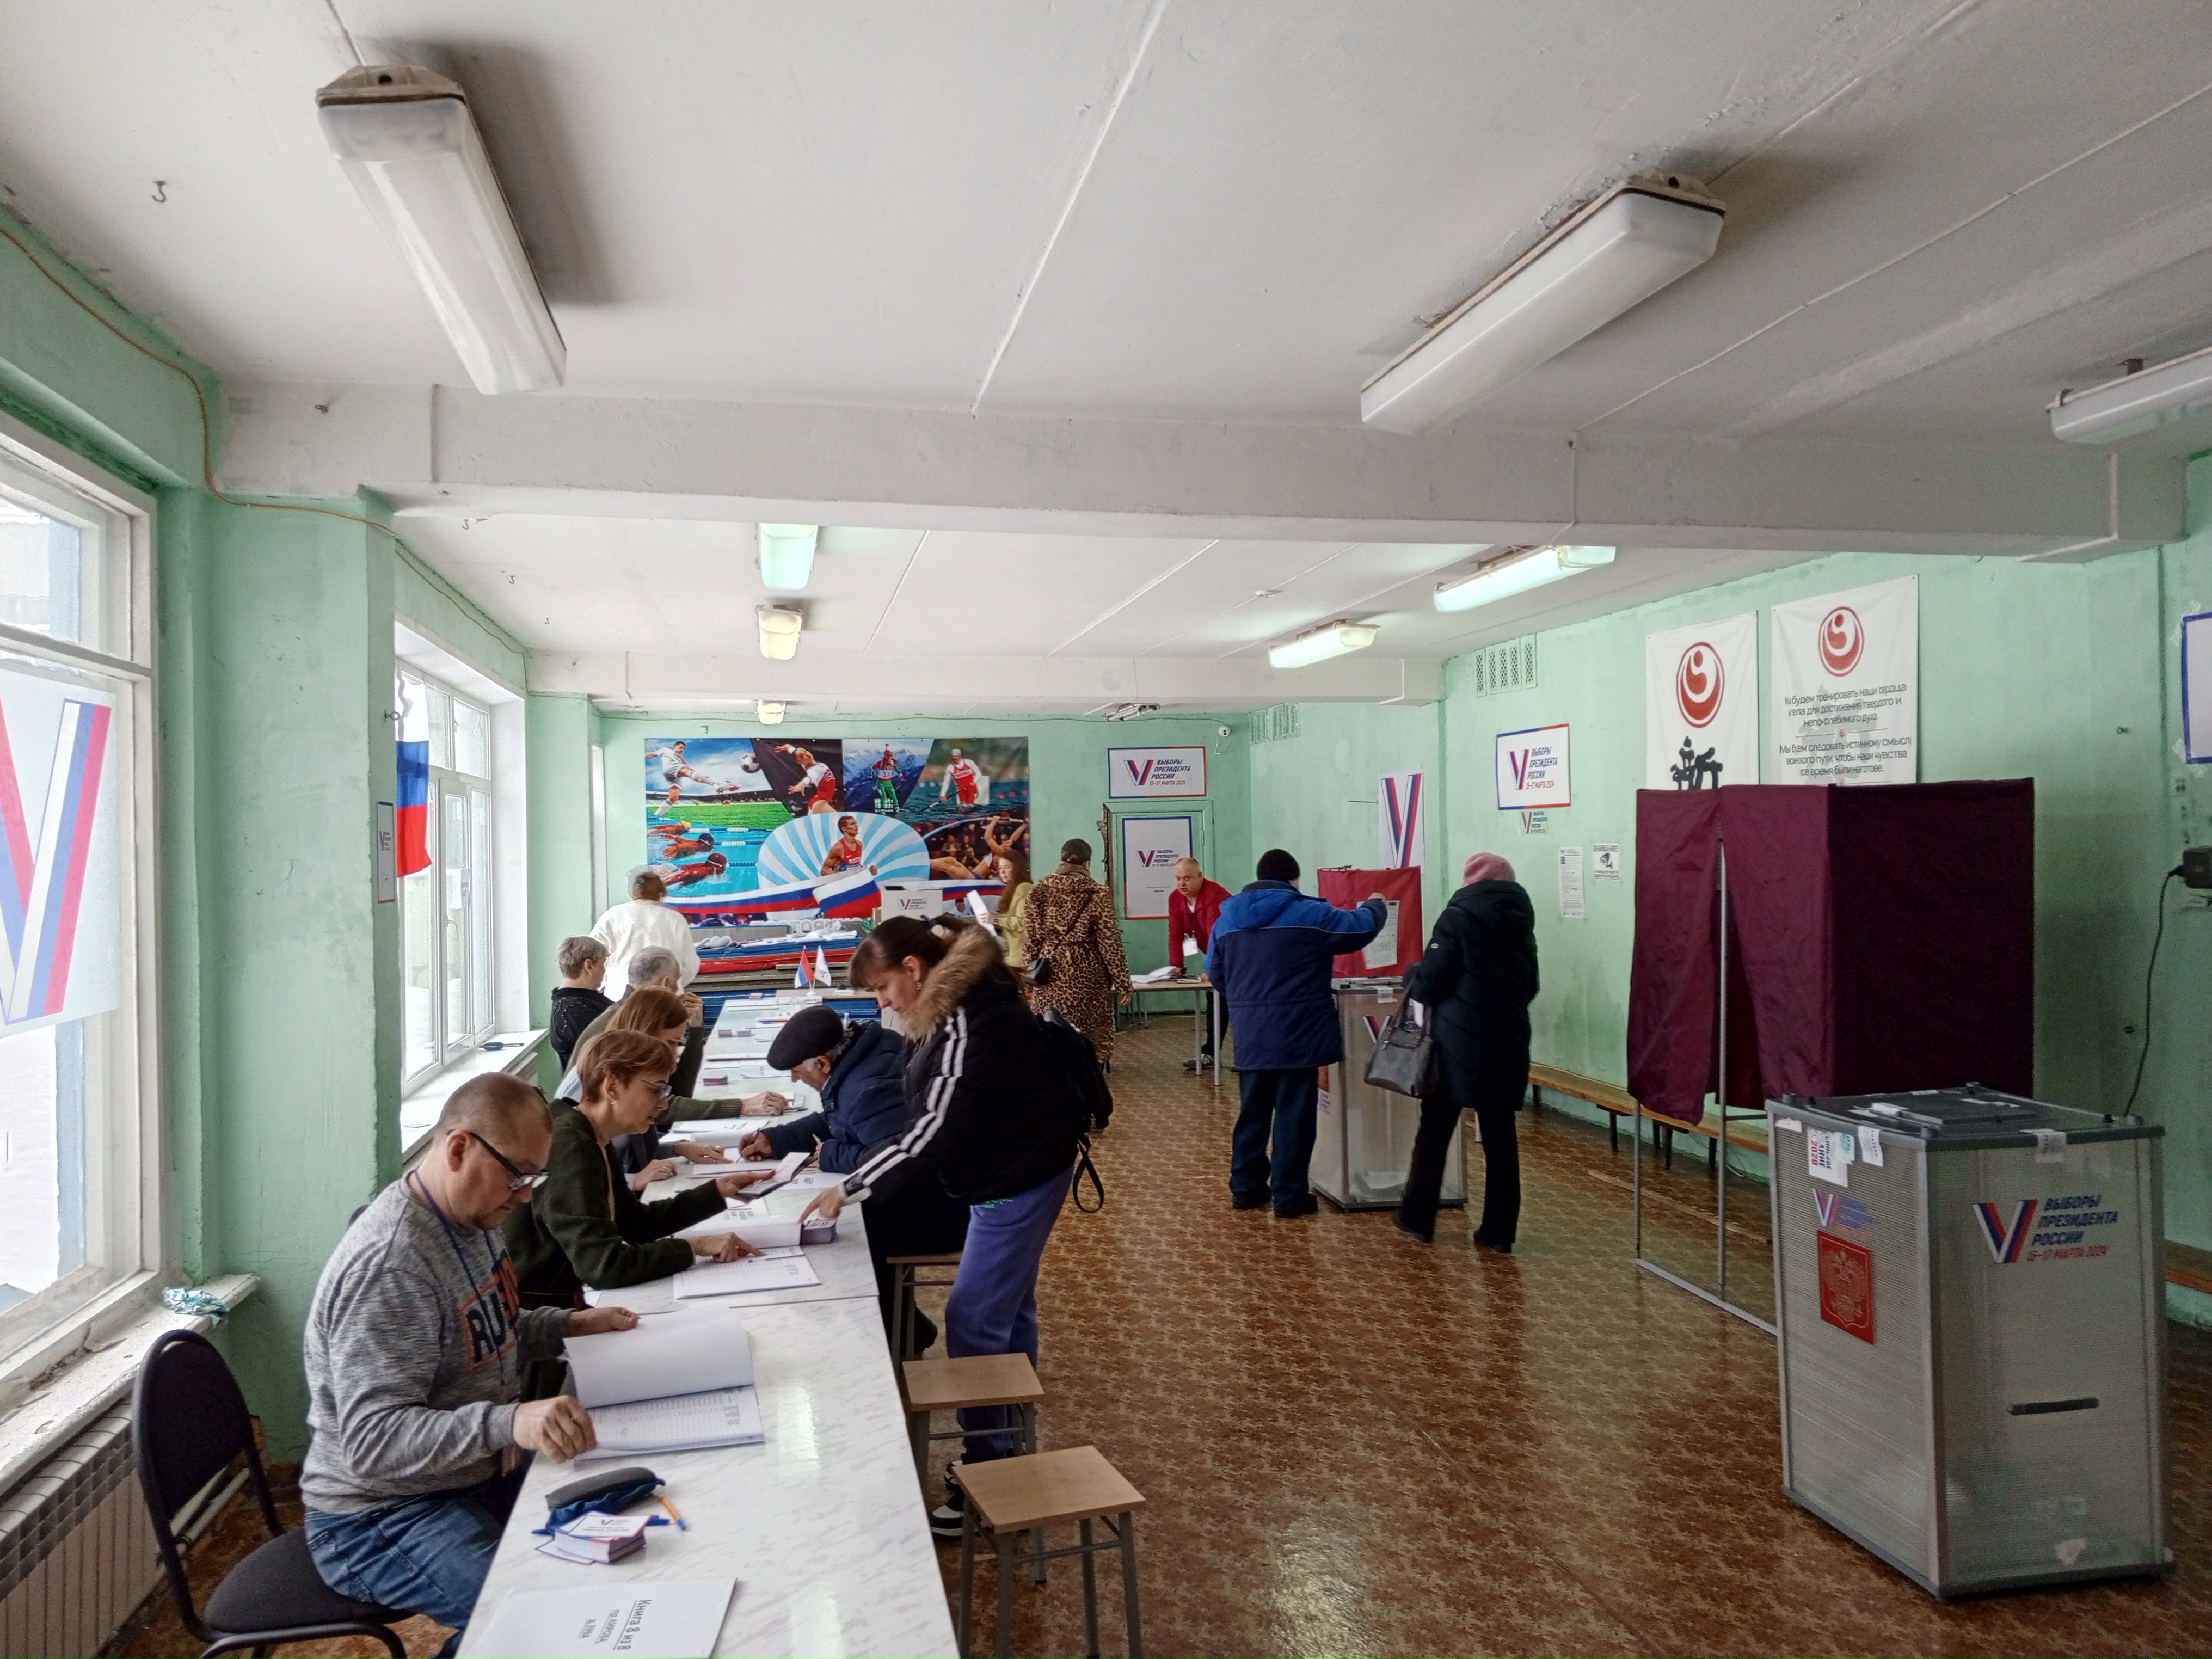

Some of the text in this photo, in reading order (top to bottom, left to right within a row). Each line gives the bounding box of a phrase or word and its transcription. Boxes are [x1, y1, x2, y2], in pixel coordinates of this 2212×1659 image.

[1791, 696, 1815, 706] будем
[1816, 690, 1859, 704] тренировать
[1859, 687, 1878, 696] наши
[1878, 683, 1907, 696] сердца
[1807, 706, 1820, 716] для
[1821, 702, 1862, 714] достижения
[1863, 698, 1894, 710] твердого
[1531, 746, 1552, 757] ВЫБОРЫ
[1779, 744, 1791, 753] Мы
[1808, 742, 1845, 752] следовать
[1846, 739, 1881, 749] истинному
[1529, 757, 1558, 769] ПРЕЗИДЕНТА
[1835, 752, 1856, 763] чтобы
[1874, 750, 1907, 762] чувства
[1527, 770, 1546, 780] РОССИИ
[1810, 767, 1833, 778] время
[1834, 765, 1852, 775] были
[2044, 1194, 2102, 1211] ВЫБОРЫ
[2038, 1210, 2118, 1228] ПРЕЗИДЕНТА
[2031, 1230, 2085, 1246] РОССИИ
[629, 1599, 652, 1625] Книга
[620, 1635, 634, 1644] из
